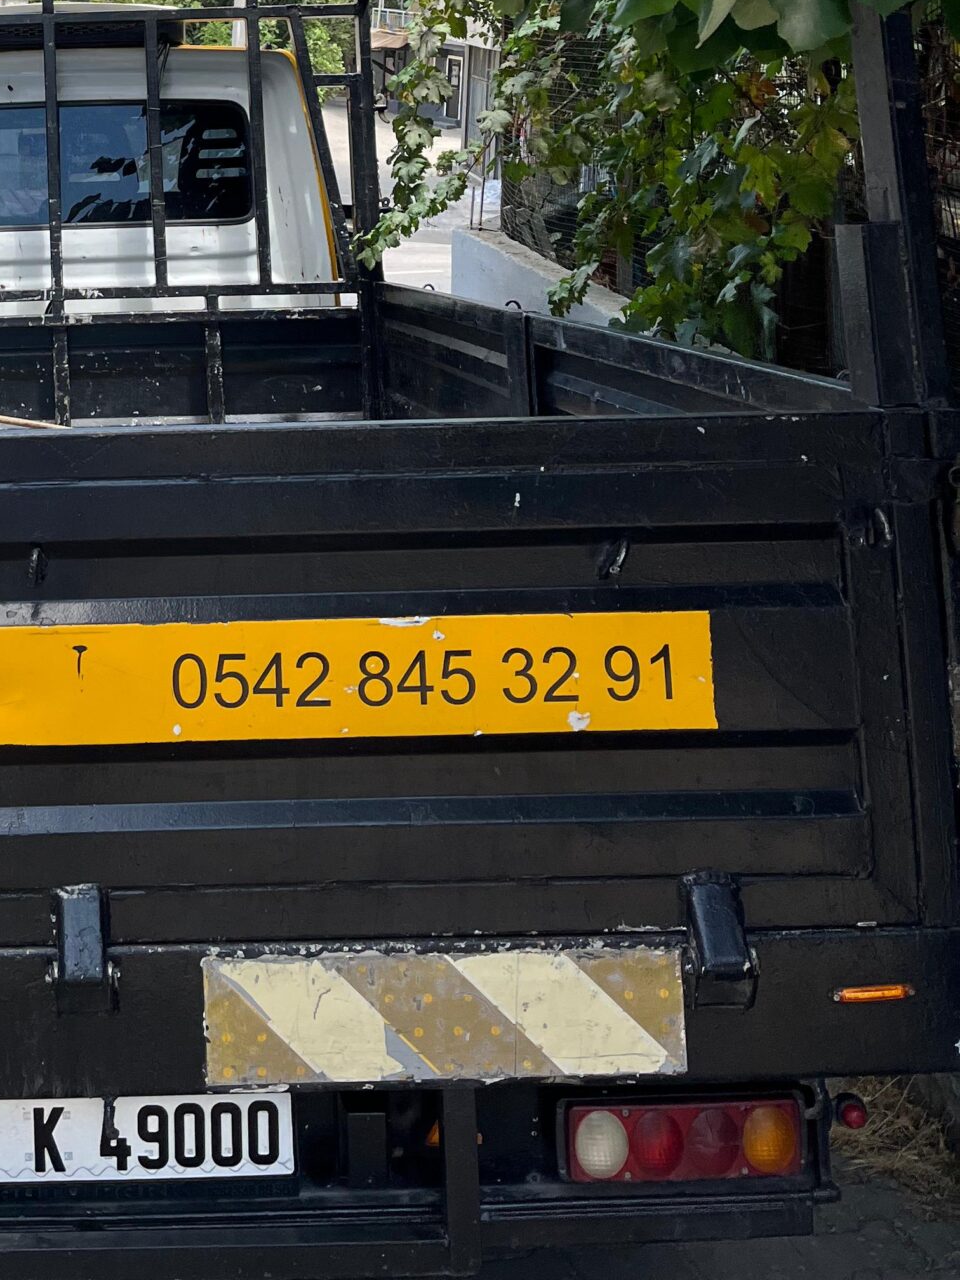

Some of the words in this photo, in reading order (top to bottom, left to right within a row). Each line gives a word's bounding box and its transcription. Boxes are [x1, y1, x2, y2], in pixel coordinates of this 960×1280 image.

[172, 652, 332, 709] 0542
[357, 649, 476, 707] 845
[501, 646, 580, 704] 32
[604, 643, 674, 702] 91
[33, 1106, 66, 1173] K
[99, 1100, 280, 1171] 49000
